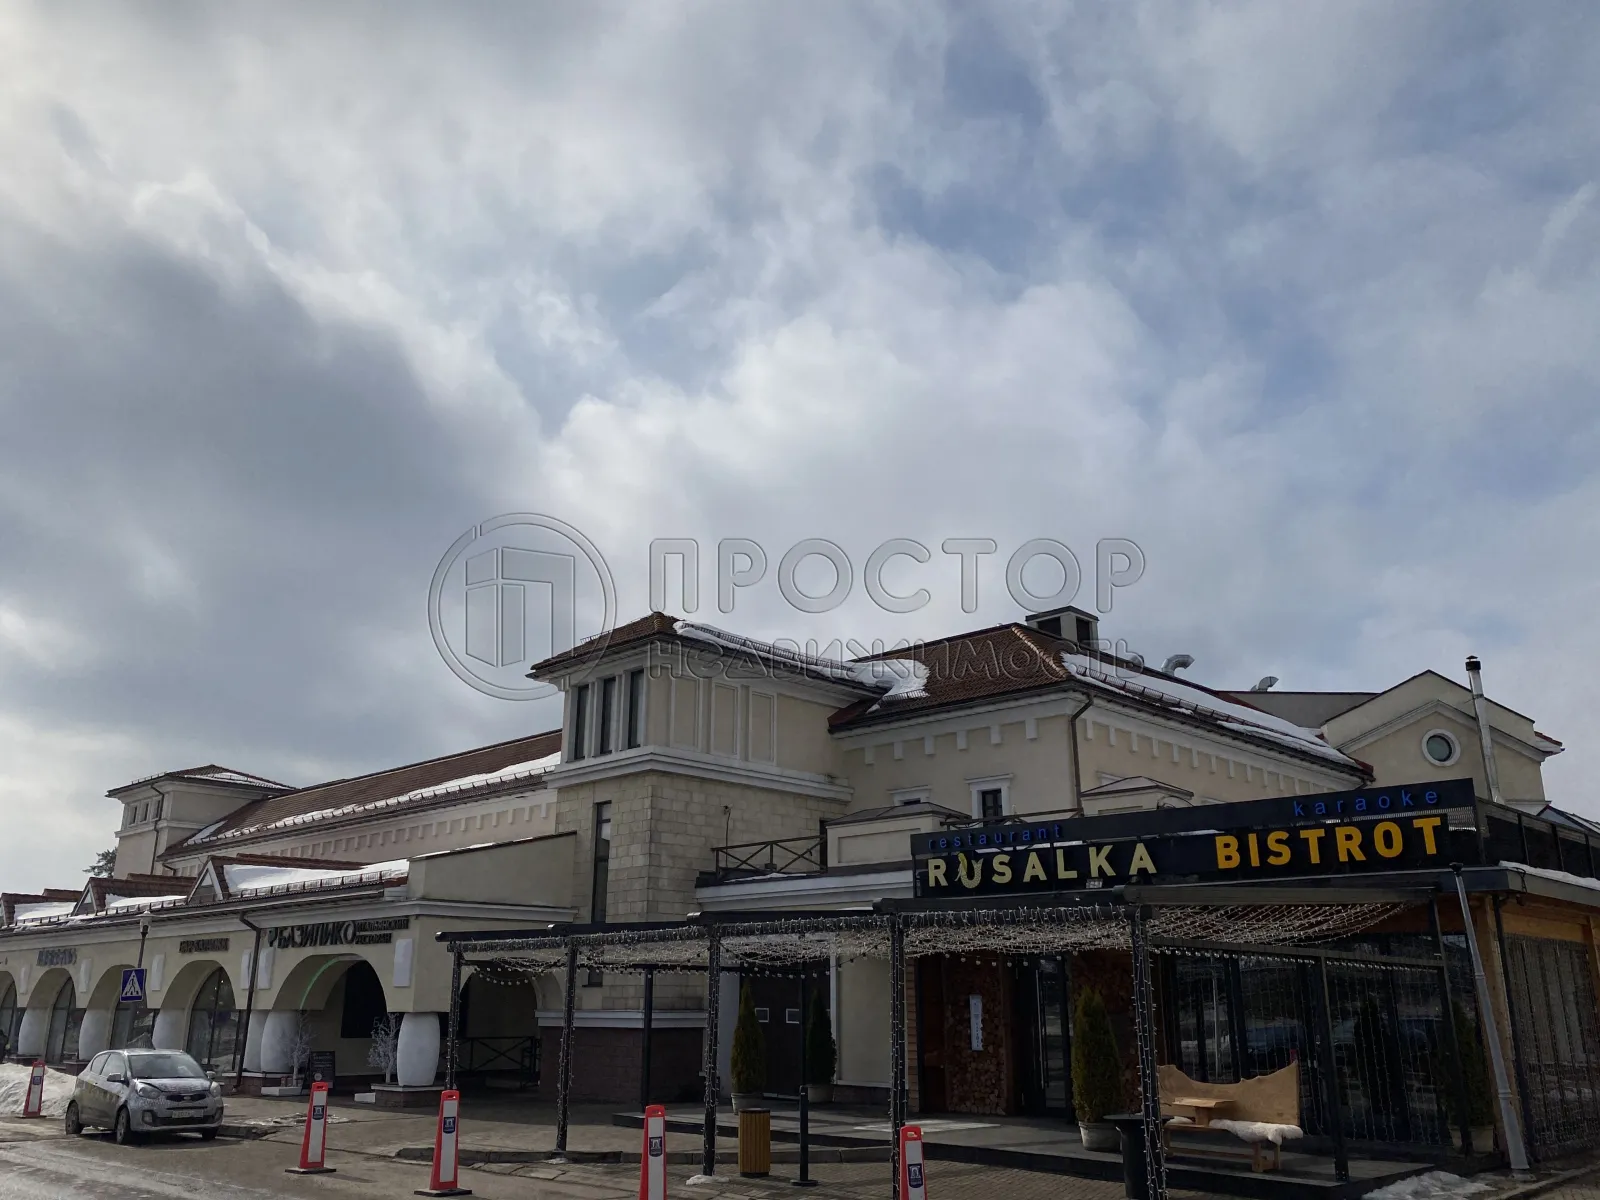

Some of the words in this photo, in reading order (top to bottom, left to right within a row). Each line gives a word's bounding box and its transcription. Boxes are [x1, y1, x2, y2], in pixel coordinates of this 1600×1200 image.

[1294, 789, 1439, 817] karaoke
[928, 824, 1061, 850] restaurant
[1215, 817, 1442, 869] BISTROT
[928, 842, 1157, 889] RUSALKA
